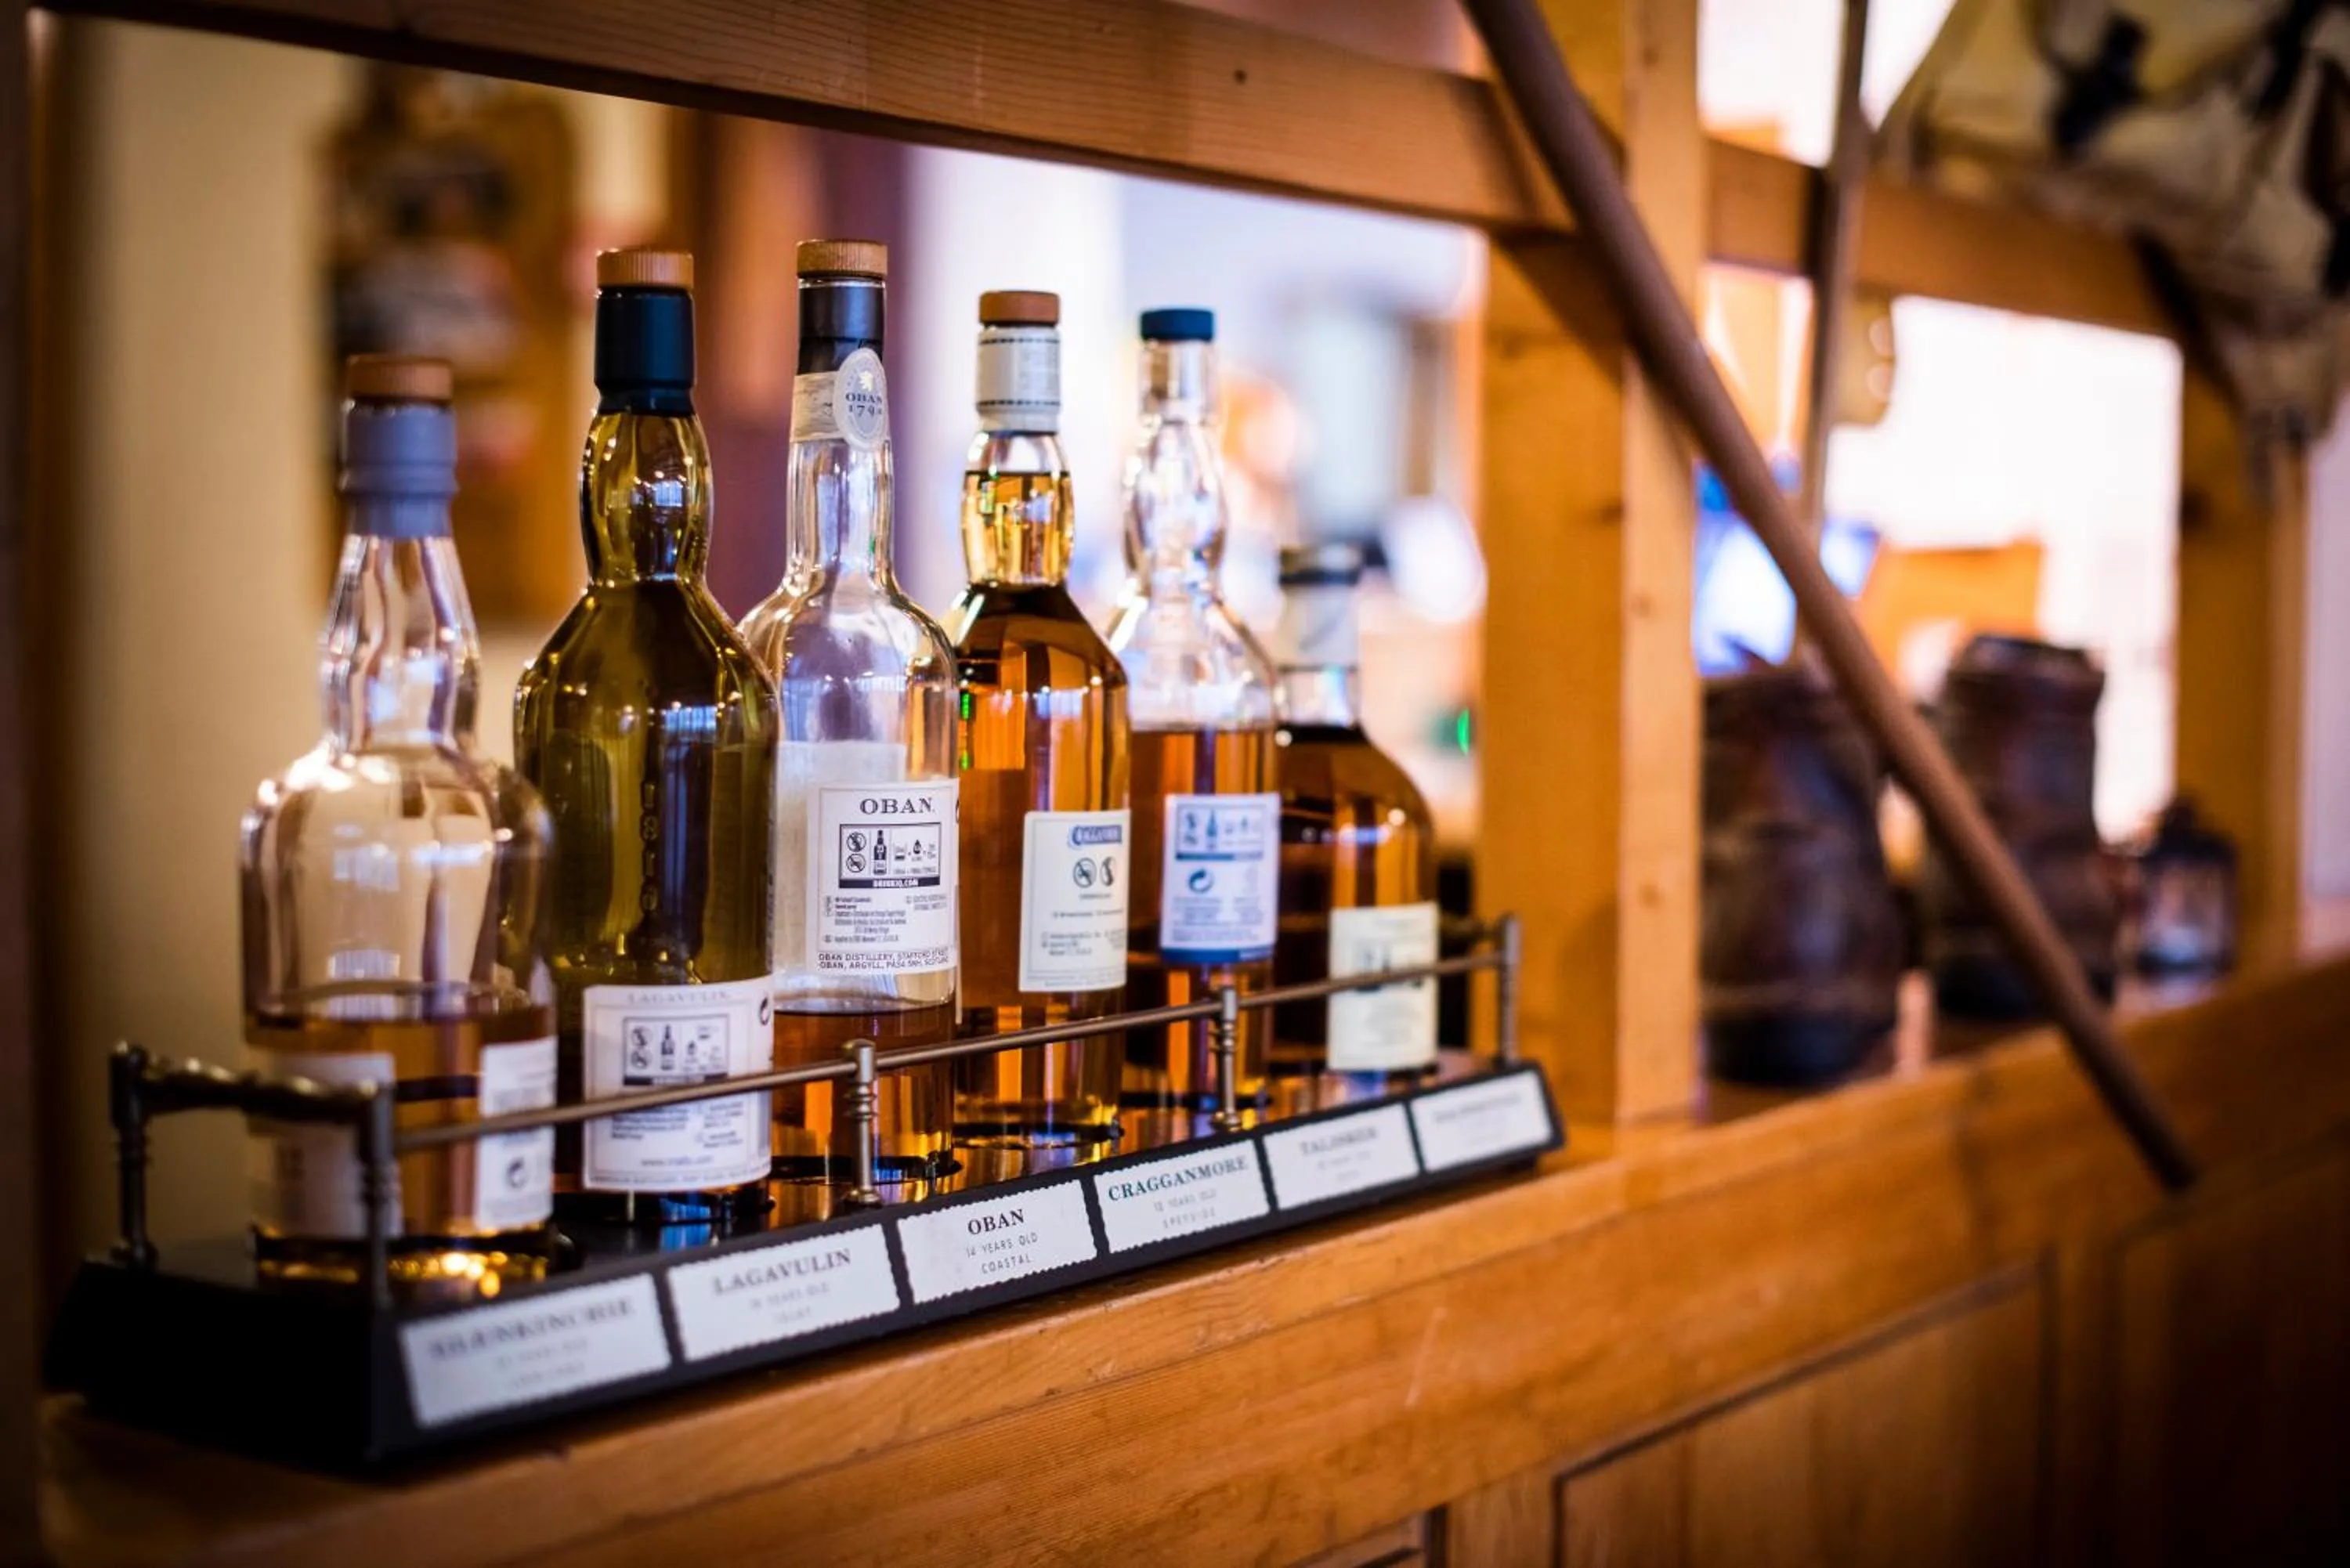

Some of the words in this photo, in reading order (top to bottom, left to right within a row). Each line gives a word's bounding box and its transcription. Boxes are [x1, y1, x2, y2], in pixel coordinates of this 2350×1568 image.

[859, 797, 933, 815] OBAN
[1108, 1154, 1249, 1201] CRAGGANMORE
[967, 1209, 1025, 1235] OBAN
[966, 1246, 976, 1258] 14
[981, 1238, 1013, 1254] YEARS
[1019, 1232, 1039, 1245] OLD
[713, 1248, 851, 1294] LAGAVULIN
[982, 1255, 1032, 1274] COASTAL
